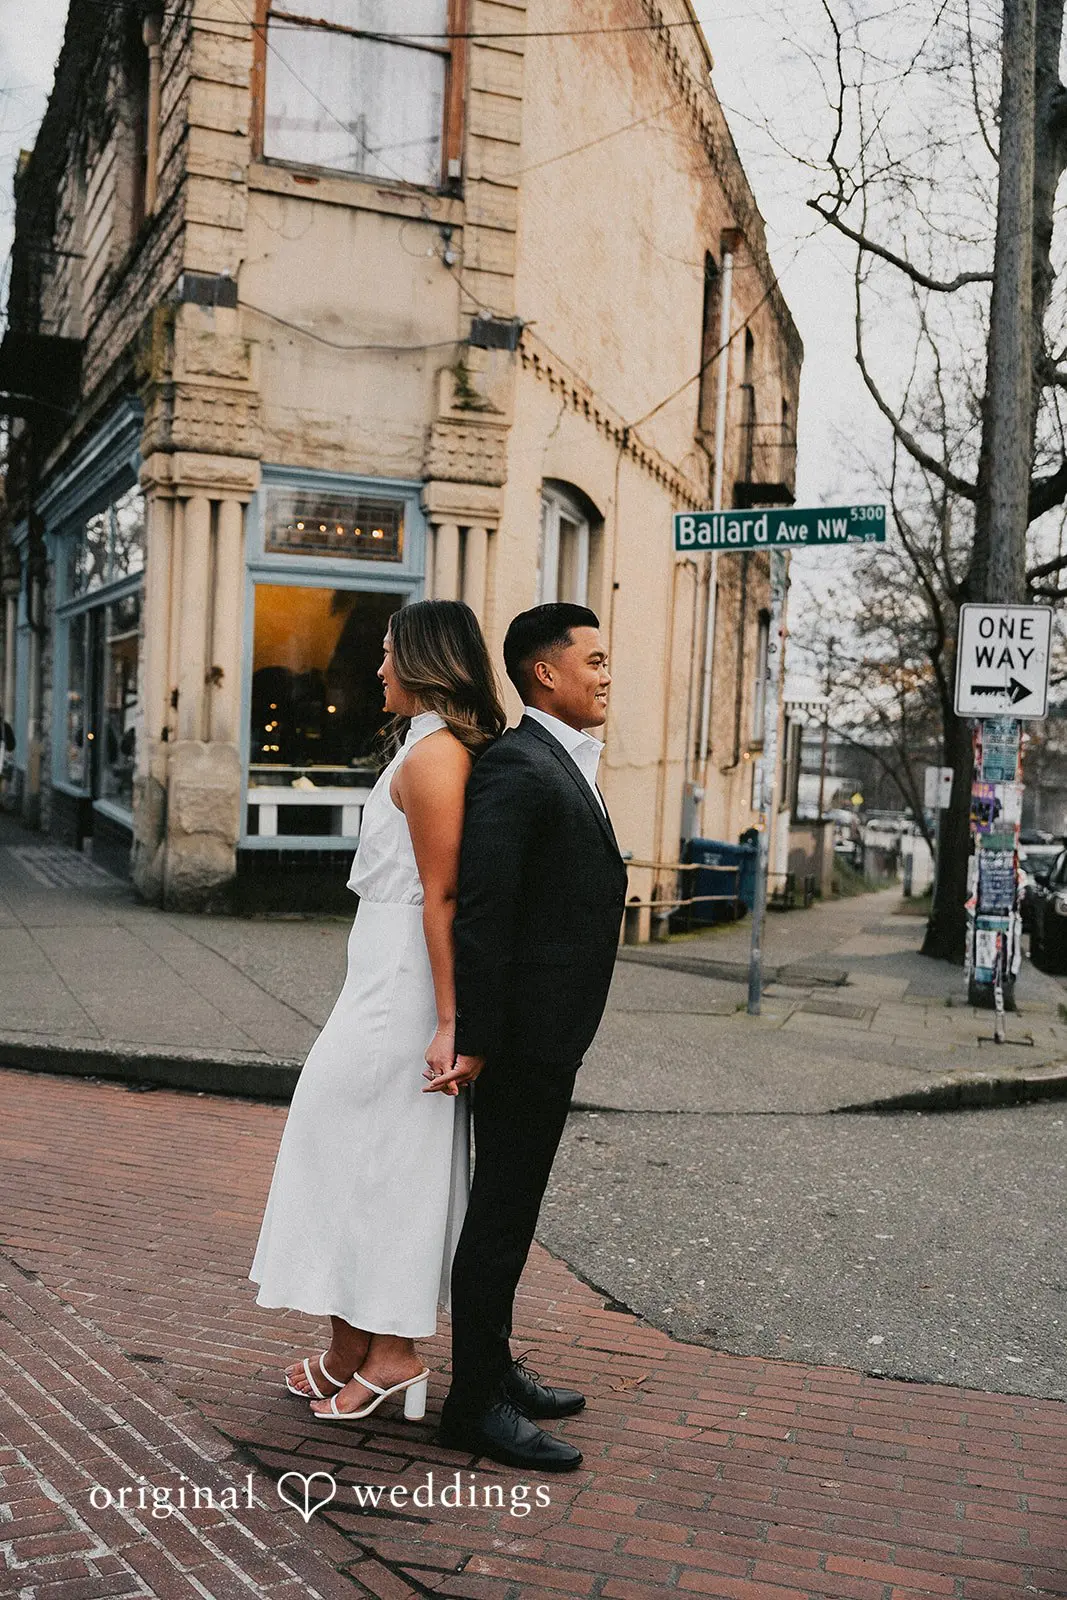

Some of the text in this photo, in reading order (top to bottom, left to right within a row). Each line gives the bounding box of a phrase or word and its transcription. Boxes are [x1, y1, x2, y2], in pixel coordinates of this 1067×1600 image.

[850, 506, 884, 521] 5300
[679, 513, 848, 545] Ballard Ave NW
[979, 616, 1034, 640] ONE
[975, 645, 1035, 670] WAY
